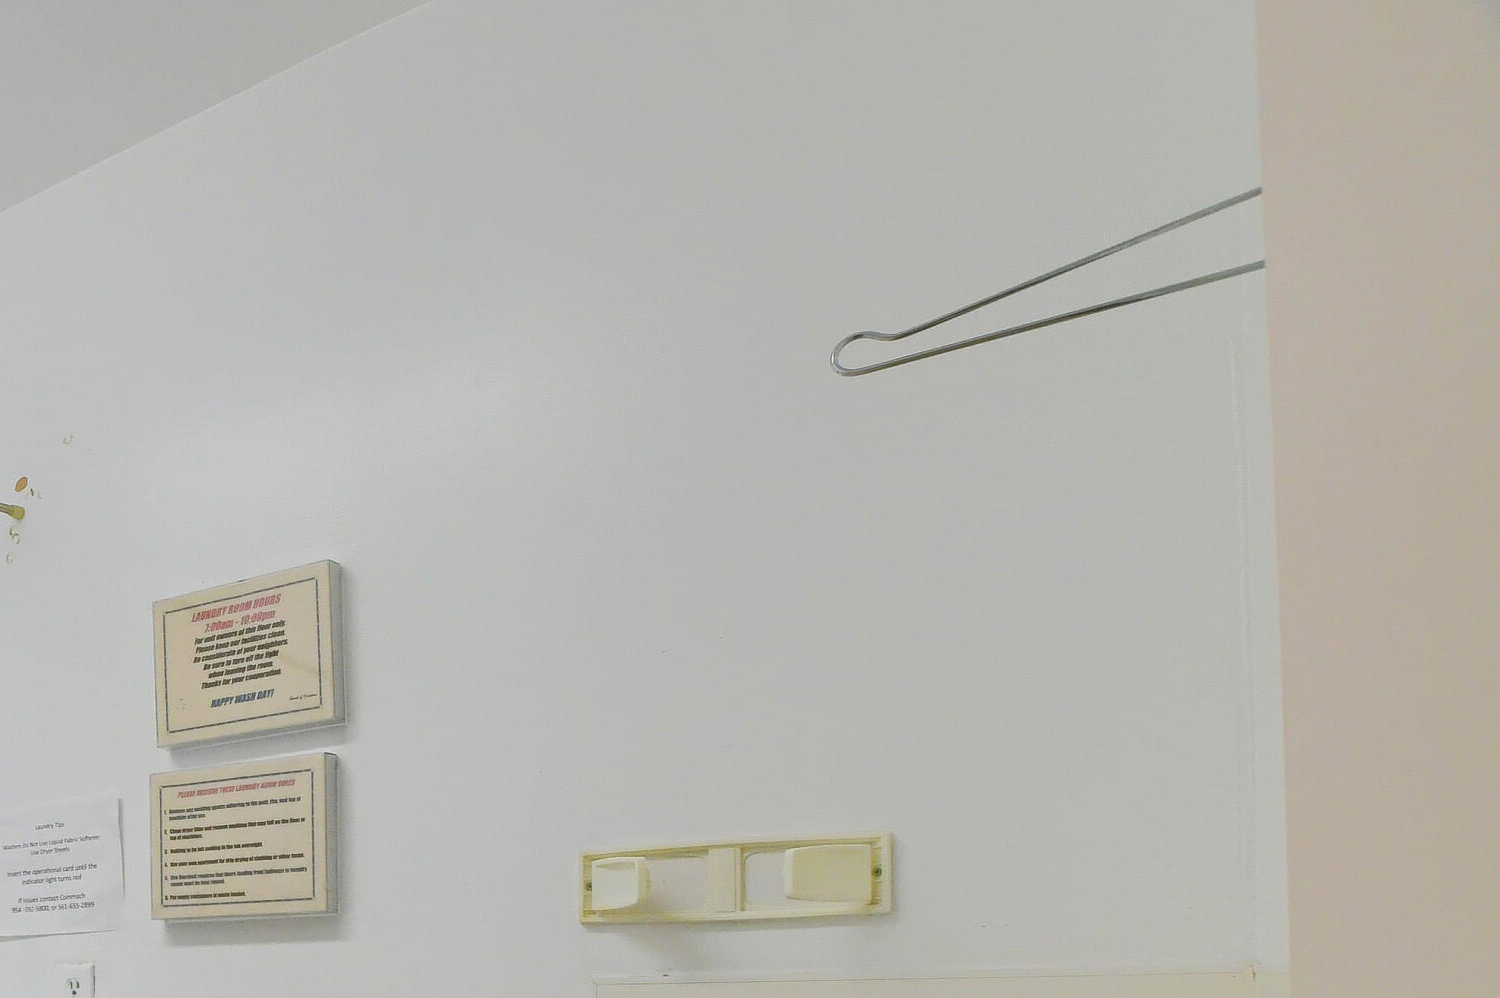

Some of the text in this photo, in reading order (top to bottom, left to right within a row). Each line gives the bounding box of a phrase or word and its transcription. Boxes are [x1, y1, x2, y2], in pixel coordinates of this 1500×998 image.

[192, 593, 281, 622] LAUNDRY ROOM HOURS
[211, 696, 235, 708] HAPPY
